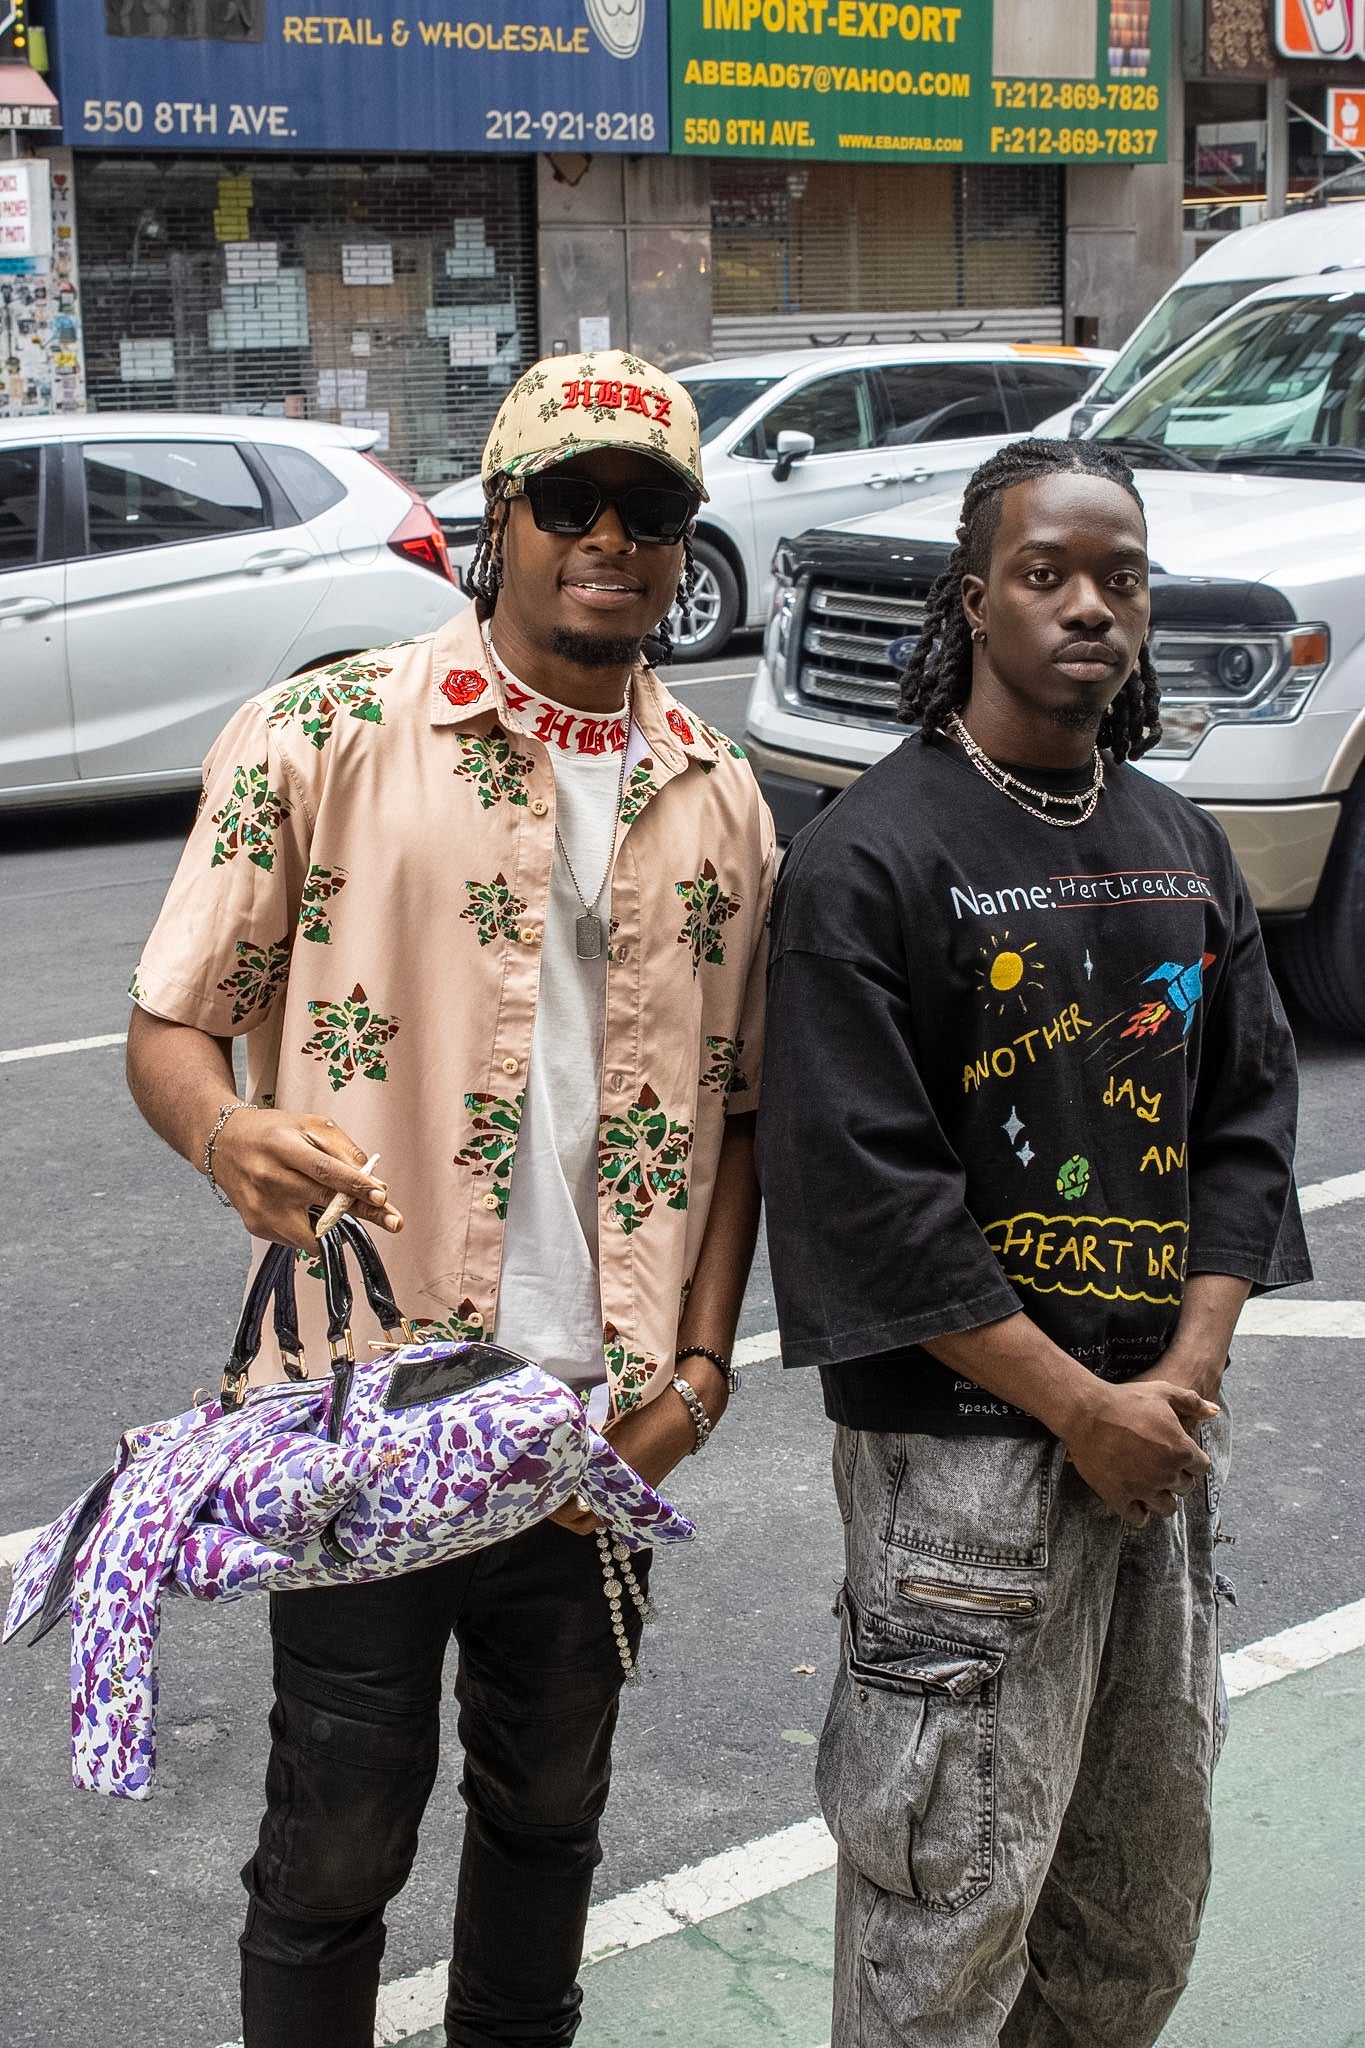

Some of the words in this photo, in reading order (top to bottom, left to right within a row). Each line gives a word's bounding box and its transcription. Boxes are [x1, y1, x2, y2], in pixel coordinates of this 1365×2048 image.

[282, 16, 383, 45] RETAIL
[391, 19, 409, 46] &
[418, 22, 590, 53] WHOLESALE
[702, 0, 962, 43] IMPORT-EXPORT
[684, 59, 971, 97] ABEBAD67@YAHOO.COM
[991, 81, 1159, 111] T:212-869-7826
[83, 100, 143, 132] 550
[154, 102, 217, 134] 8TH
[227, 104, 297, 136] AVE.
[485, 110, 656, 141] 212-921-8218
[684, 118, 721, 145] 550
[725, 119, 765, 146] 8TH
[770, 120, 816, 147] AVE.
[838, 134, 964, 152] WWW.EBADFAB.COM
[990, 126, 1158, 155] F:212-869-7837
[561, 379, 672, 427] HBKZ
[950, 884, 1057, 919] Name:
[963, 1002, 1093, 1093] ANOTHER
[1003, 1228, 1134, 1274] HEART
